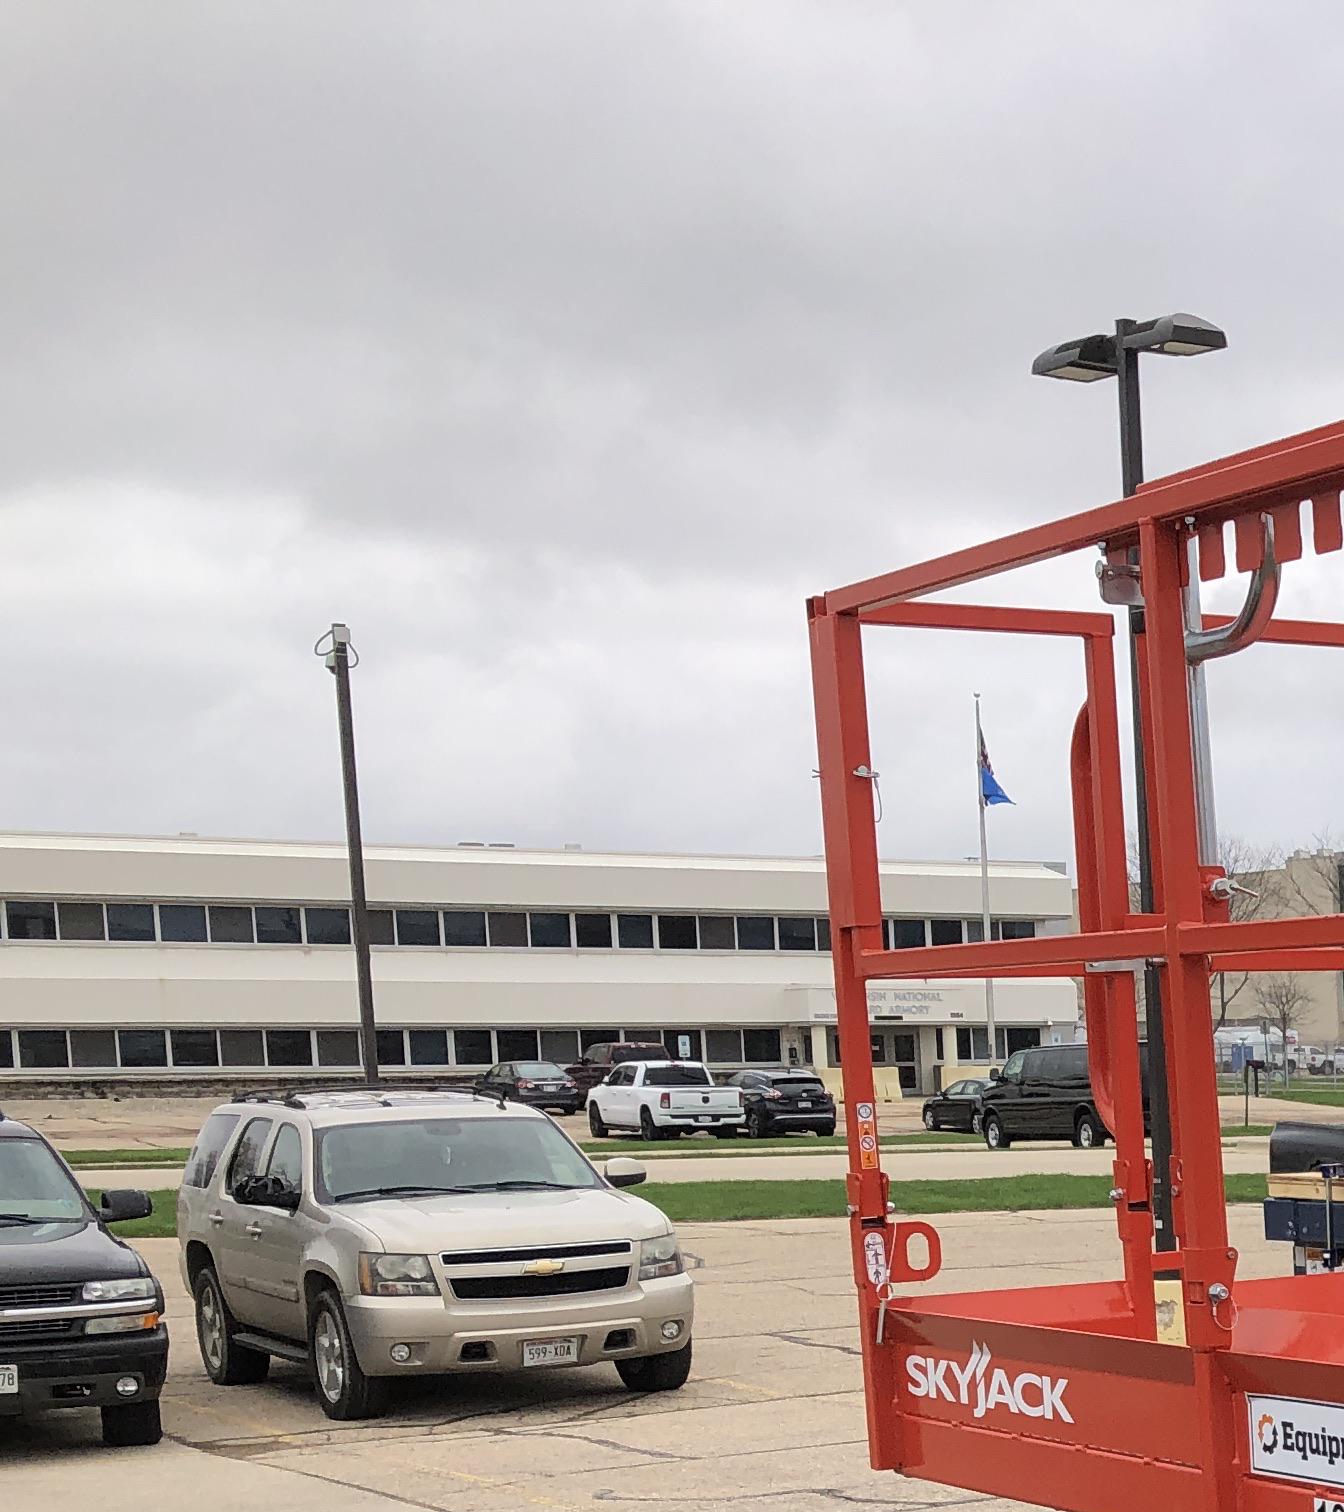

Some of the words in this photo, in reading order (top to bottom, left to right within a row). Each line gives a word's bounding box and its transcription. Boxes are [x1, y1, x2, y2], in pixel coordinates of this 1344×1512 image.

[894, 992, 943, 1001] NATIONAL
[888, 1005, 931, 1015] ARMORY
[528, 1345, 572, 1360] 599-XDA
[906, 1339, 1075, 1424] SKYJACK
